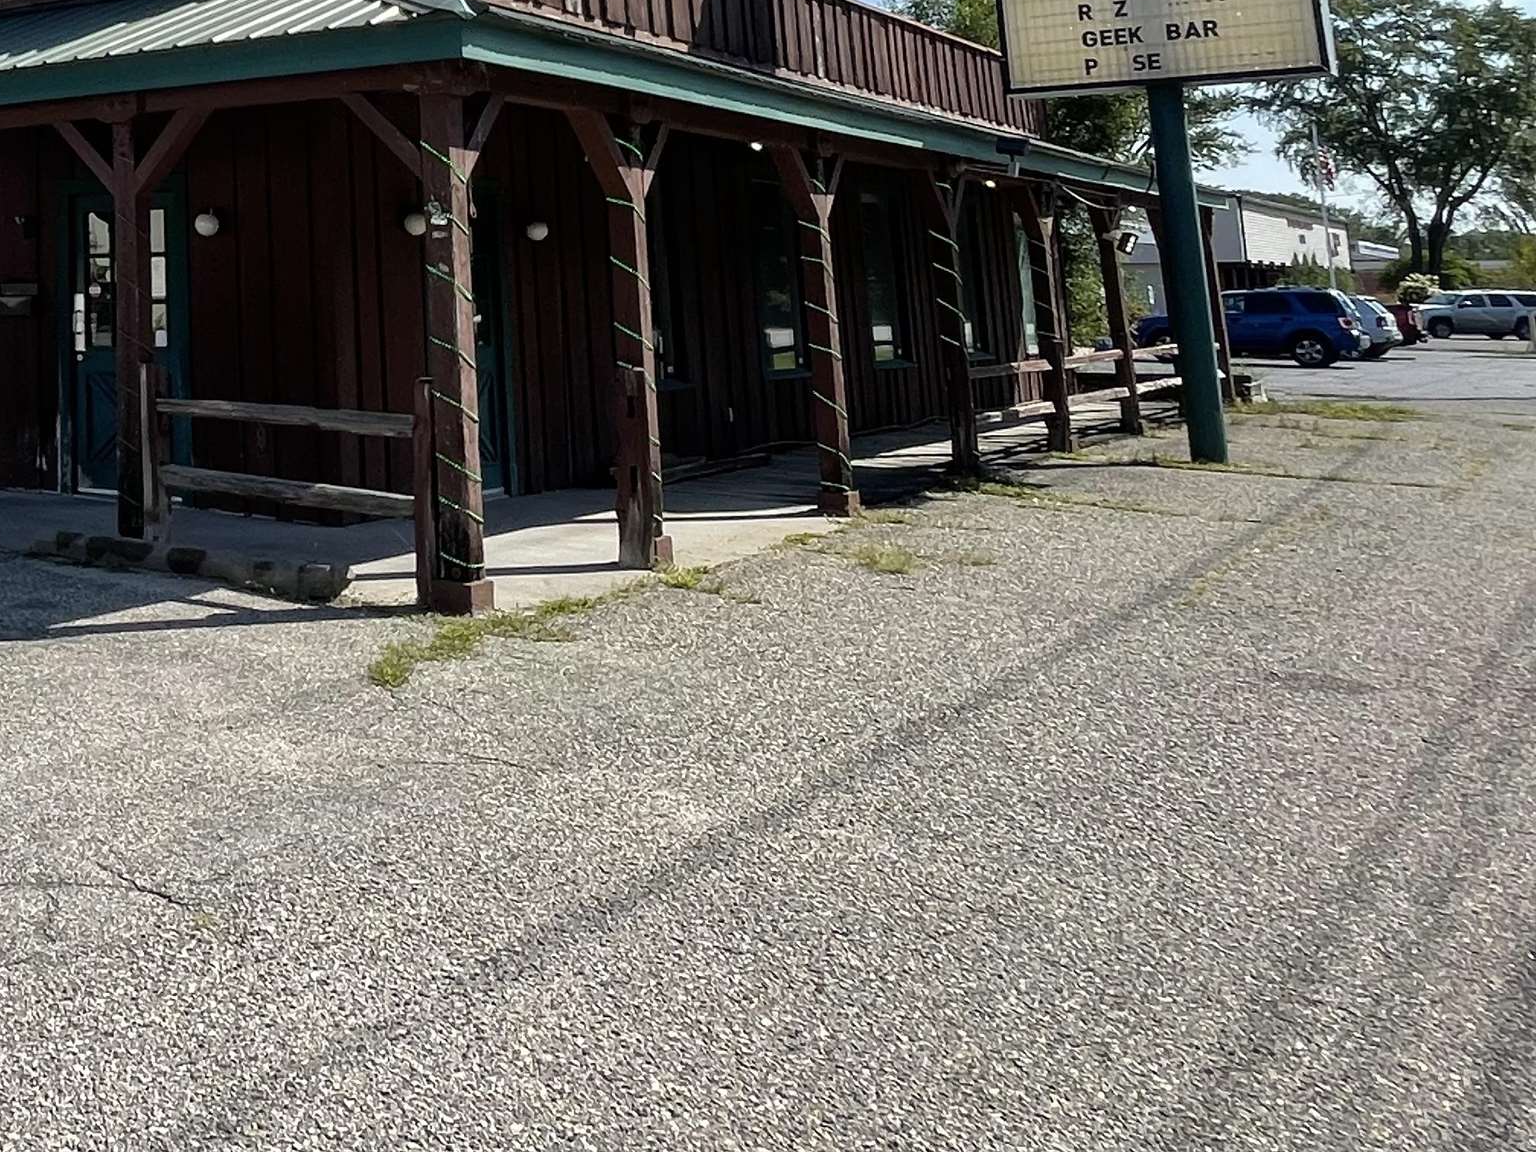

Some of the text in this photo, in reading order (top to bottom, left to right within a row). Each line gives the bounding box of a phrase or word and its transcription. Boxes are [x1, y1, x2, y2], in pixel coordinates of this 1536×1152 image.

[1077, 0, 1129, 22] R Z
[1081, 19, 1220, 48] GEEK BAR
[1083, 52, 1163, 76] P SE
